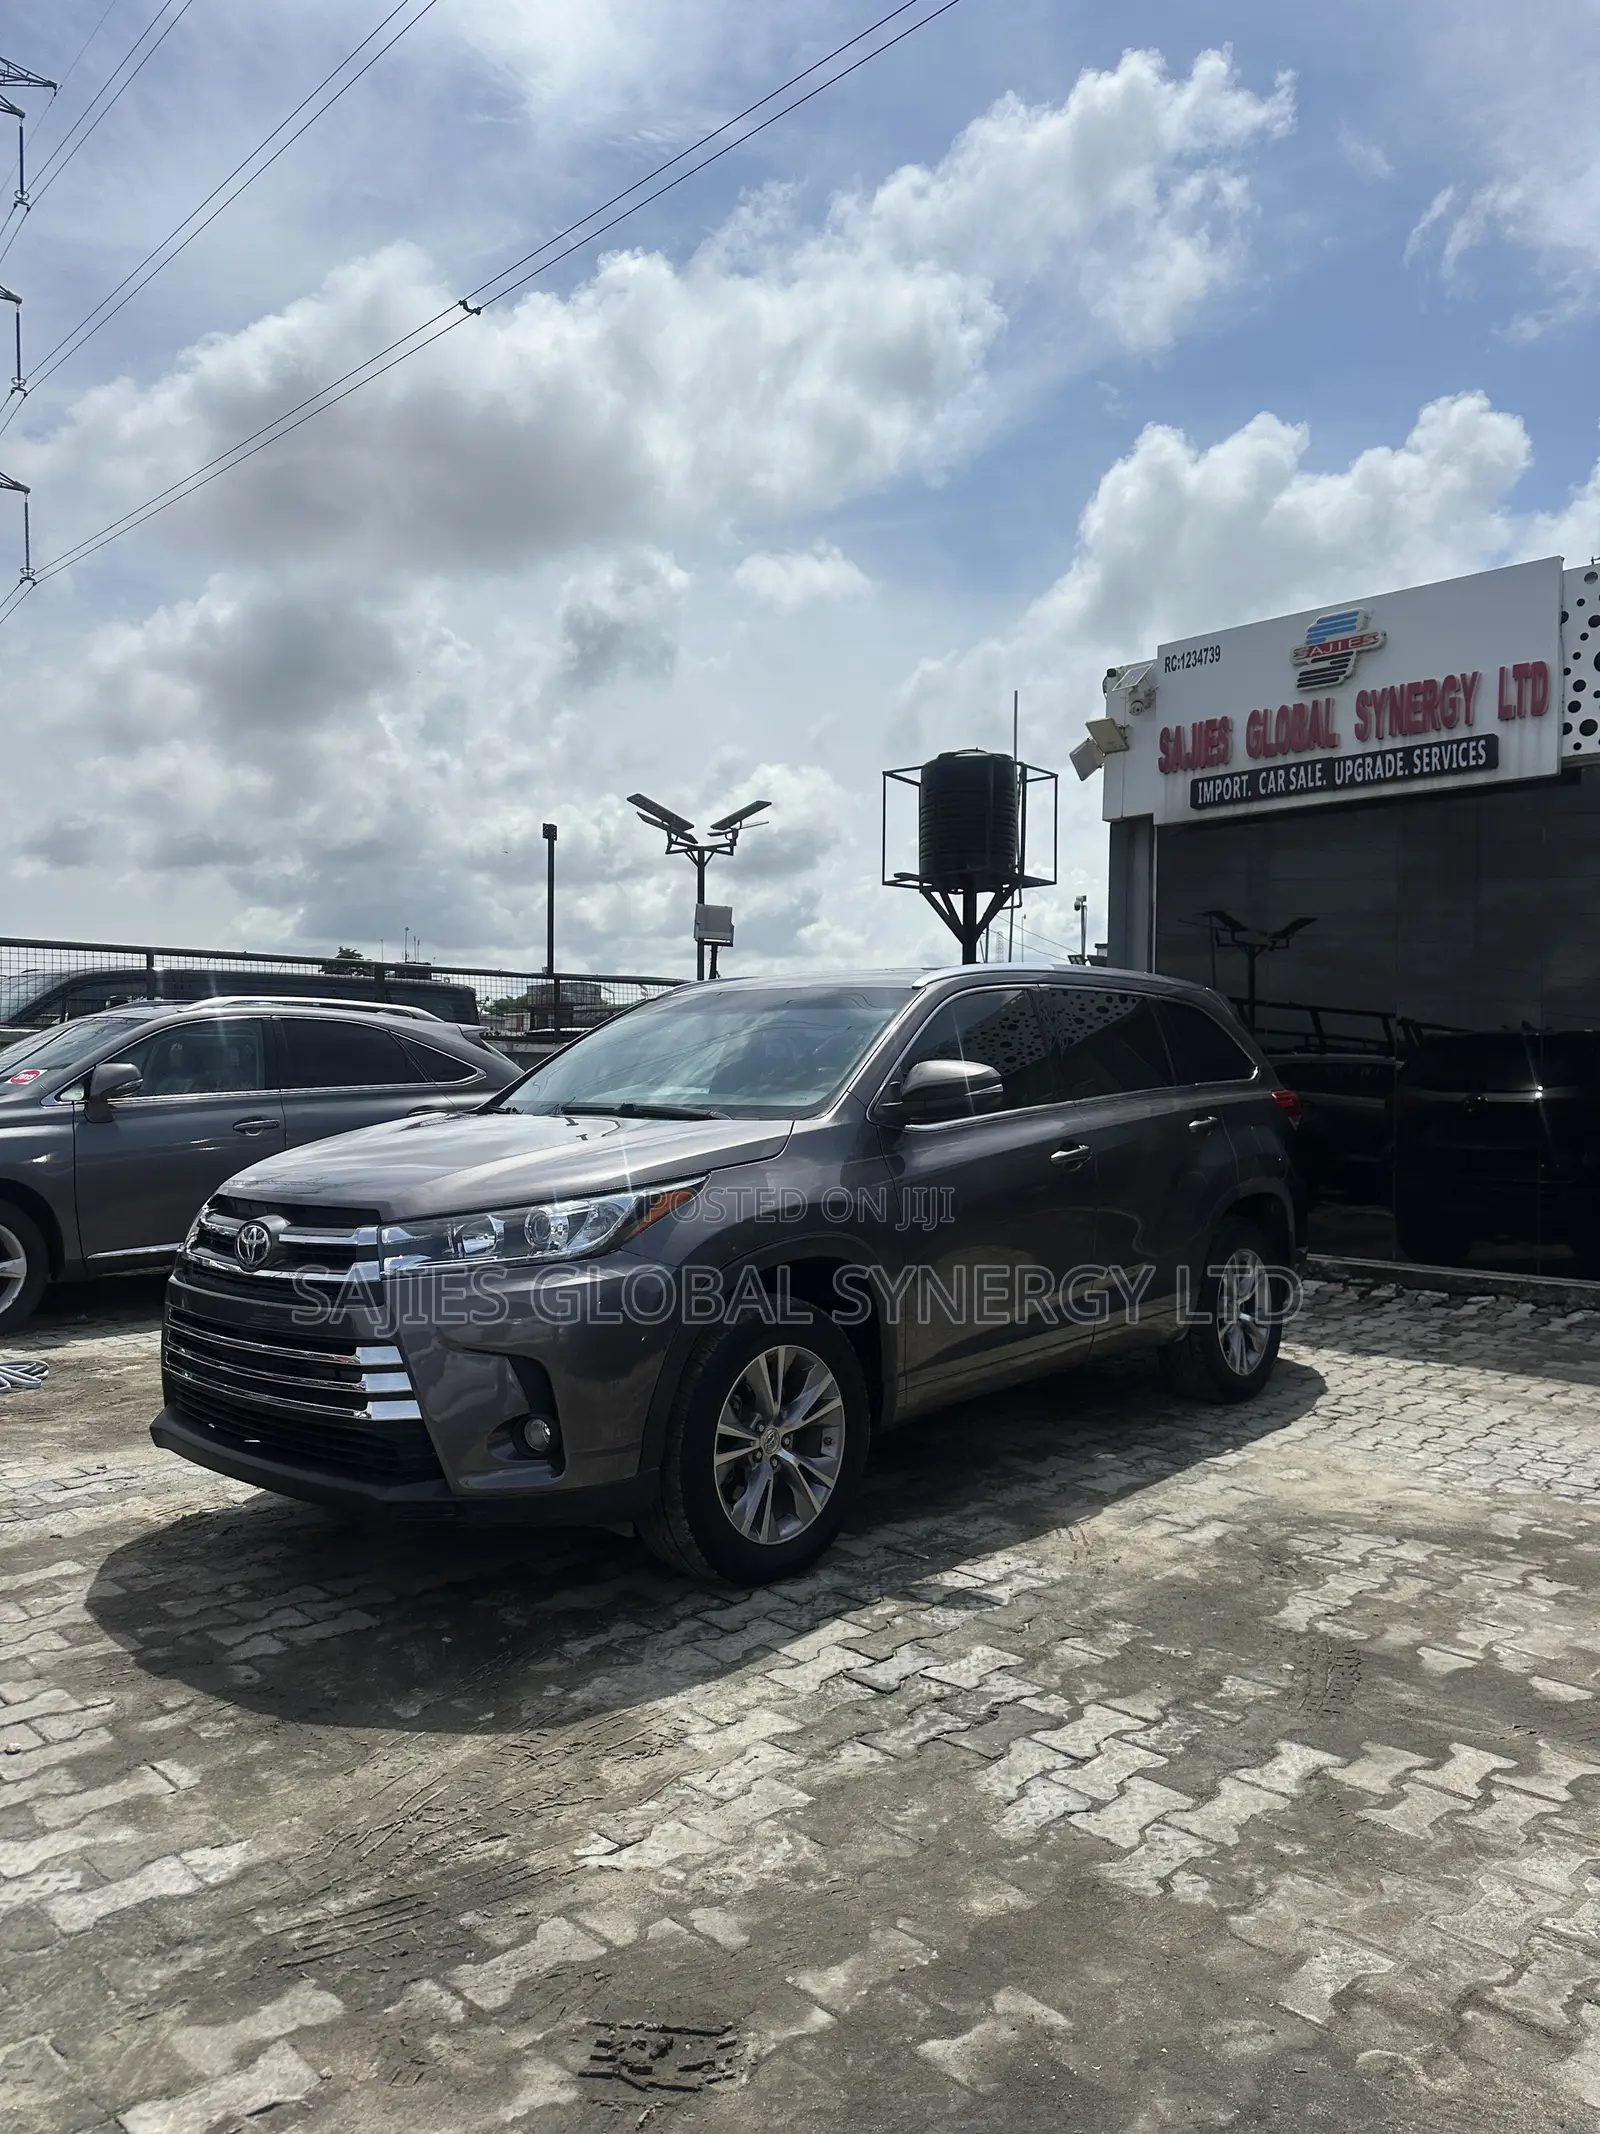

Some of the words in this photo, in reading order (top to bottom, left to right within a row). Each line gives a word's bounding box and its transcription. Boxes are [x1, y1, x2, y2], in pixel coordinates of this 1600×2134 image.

[1164, 645, 1221, 673] RC:1234739
[1293, 631, 1380, 660] SAJIES
[1158, 716, 1233, 774] SAJIES
[1246, 697, 1341, 759] GLOBAL
[1354, 671, 1481, 743] SYNERGY
[1497, 660, 1550, 721] LTD
[1197, 774, 1252, 804] IMPORT.
[1334, 752, 1408, 786] UPGRADE.
[1413, 739, 1487, 774] SERVICES
